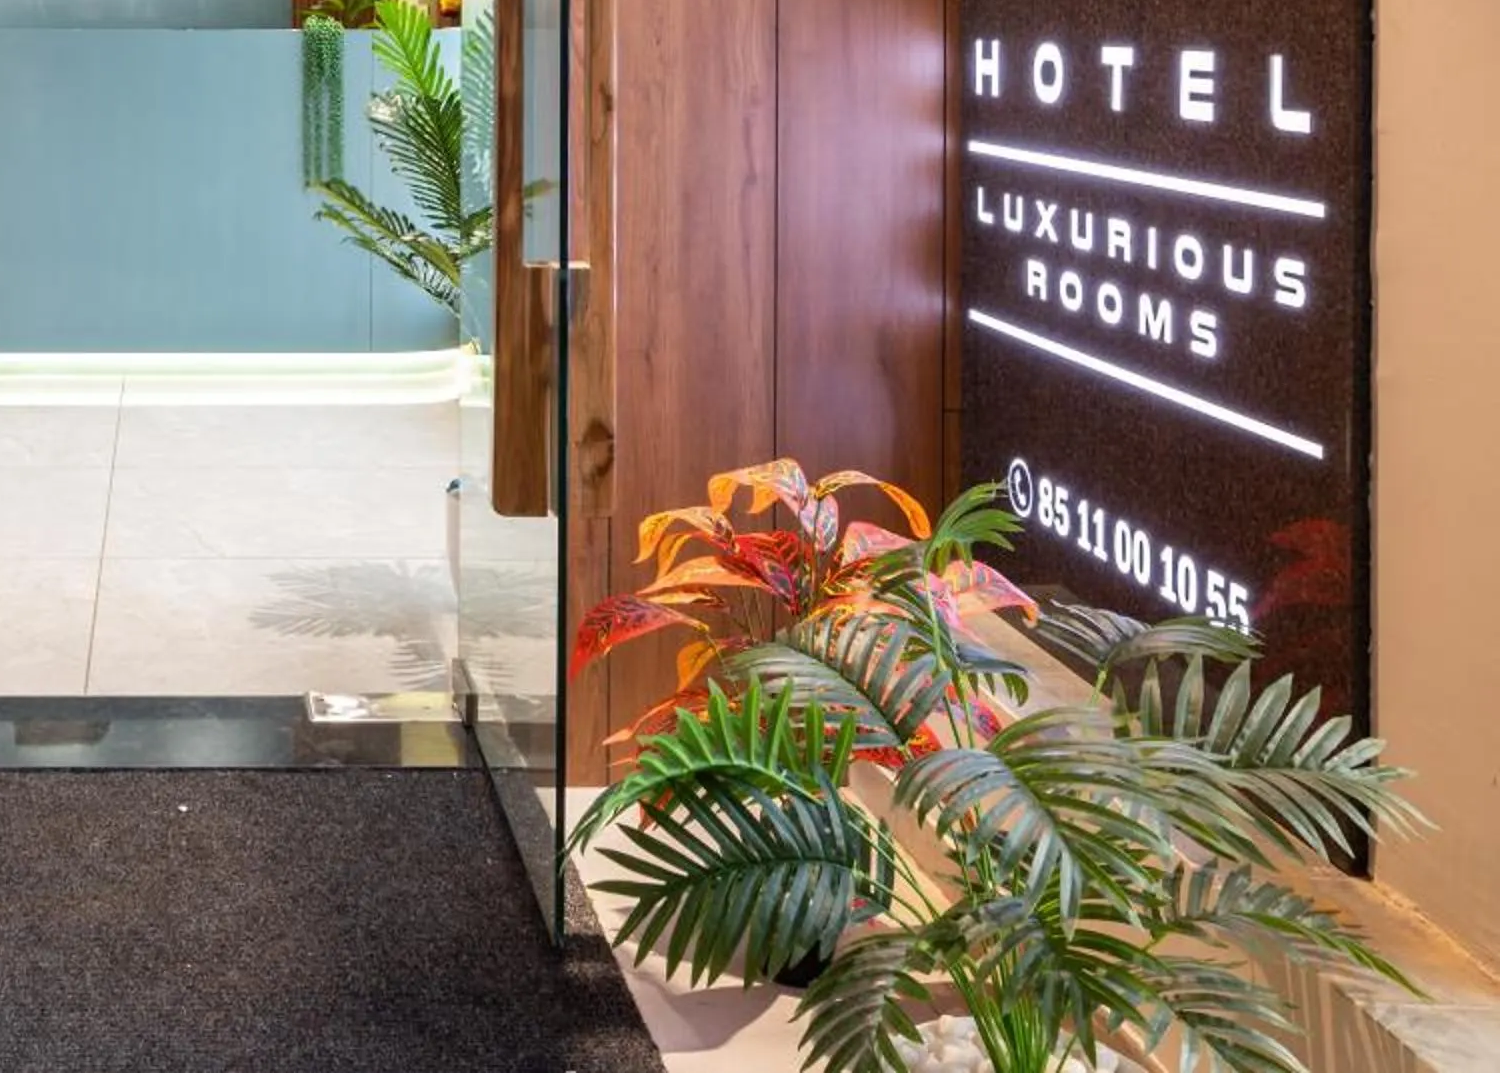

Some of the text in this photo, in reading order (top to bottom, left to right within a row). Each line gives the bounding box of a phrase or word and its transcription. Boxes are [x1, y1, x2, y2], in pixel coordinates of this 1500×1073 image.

[974, 38, 1311, 134] HOTEL
[976, 186, 1306, 308] LUXURIOUS
[1026, 260, 1218, 358] ROOMS
[1037, 478, 1249, 636] 85 11 00 10 55
